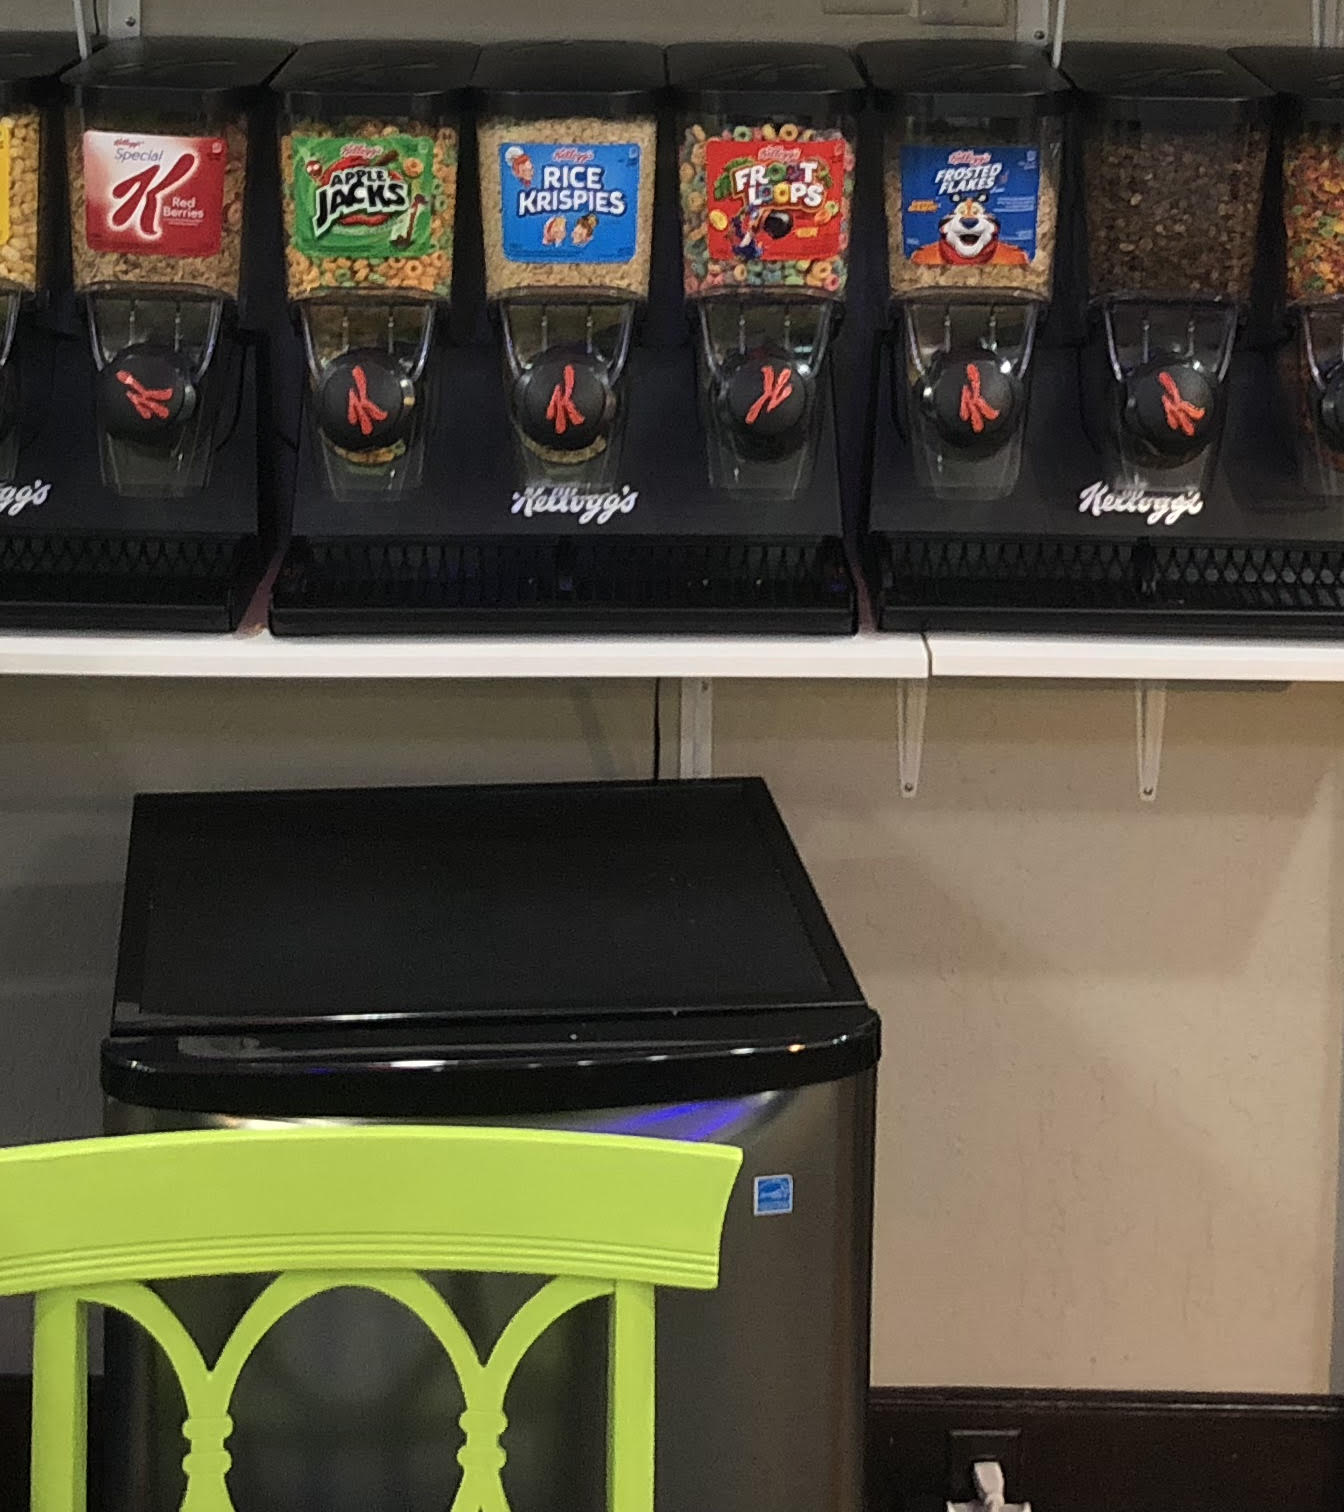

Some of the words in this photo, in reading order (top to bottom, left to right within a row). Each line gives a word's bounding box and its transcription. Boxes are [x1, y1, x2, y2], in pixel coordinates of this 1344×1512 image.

[114, 148, 164, 162] Special
[331, 170, 387, 187] APPLE
[544, 165, 602, 189] RICE
[735, 161, 818, 191] FROOT
[935, 163, 1003, 183] FROSTED
[111, 152, 197, 236] K
[749, 182, 823, 208] LOOPS
[939, 177, 995, 195] FLAKES
[163, 207, 204, 219] Berries
[172, 197, 195, 208] Red
[316, 182, 406, 233] JACKS
[519, 189, 626, 215] KRISPIES
[512, 486, 639, 524] Kellogg's
